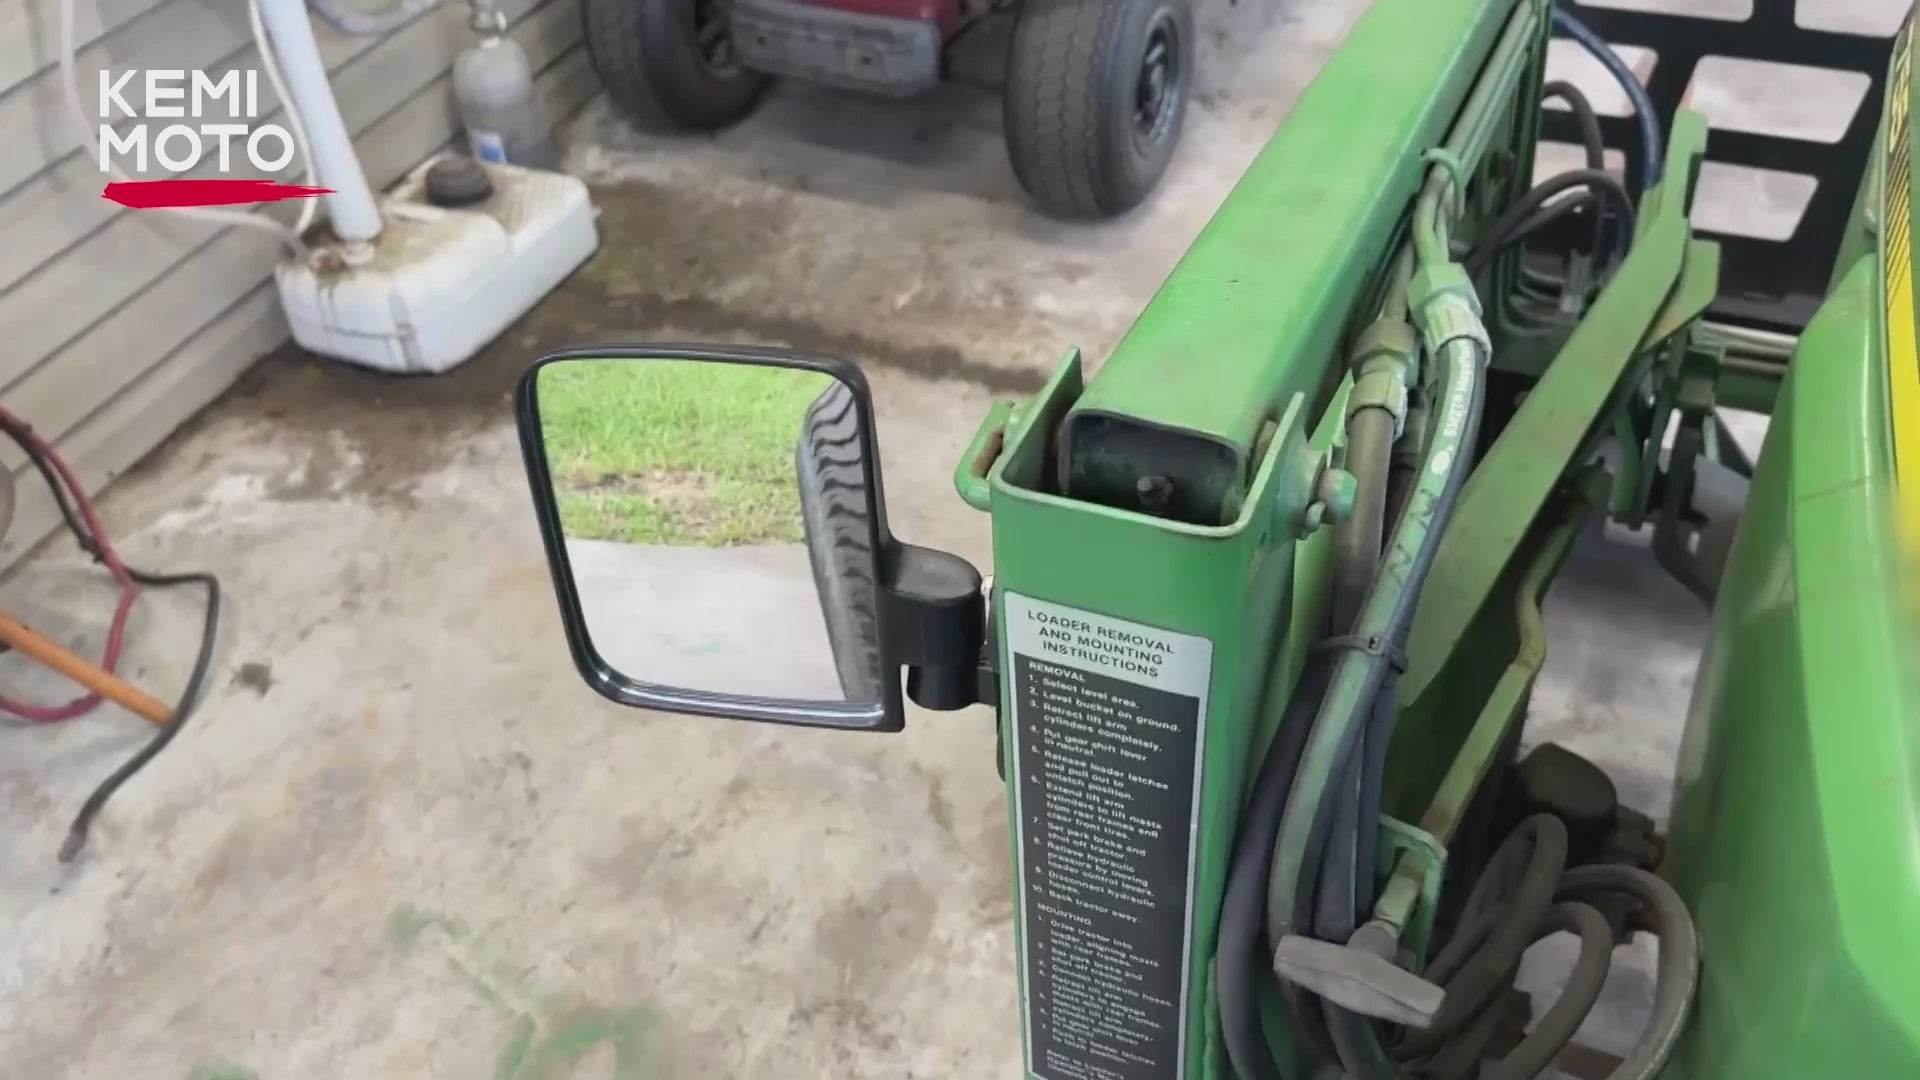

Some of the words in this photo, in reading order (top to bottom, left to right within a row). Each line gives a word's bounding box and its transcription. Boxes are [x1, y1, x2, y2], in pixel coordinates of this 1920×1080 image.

[1028, 610, 1090, 632] LOADER
[1097, 626, 1174, 654] REMOVAL
[1039, 627, 1071, 641] AND
[1078, 636, 1162, 664] MOUNTING
[1029, 661, 1085, 682] REMOVAL
[1043, 641, 1158, 677] INSTRUCTIONS
[1028, 673, 1038, 683] 1.
[1043, 678, 1077, 692] Select
[1081, 688, 1107, 700] level
[1112, 696, 1139, 708] area.
[1029, 686, 1038, 696] 2.
[1043, 691, 1071, 704] Level
[1076, 699, 1113, 714] bucket
[1118, 711, 1132, 719] on
[1136, 716, 1179, 732] ground.
[1030, 699, 1039, 708] 3.
[1044, 703, 1082, 720] Retract
[1087, 715, 1101, 724] lift
[1106, 721, 1126, 731] arm
[1044, 715, 1093, 732] cylinders
[1098, 729, 1162, 751] completely.
[1044, 728, 1060, 738] Put
[1065, 736, 1088, 745] gear
[1092, 742, 1115, 752] shift
[1120, 749, 1146, 761] lever
[1056, 742, 1096, 756] neutral.
[1045, 750, 1086, 767] Release
[1090, 763, 1124, 777] loader
[1128, 773, 1168, 789] latches
[1045, 762, 1064, 772] and
[1068, 768, 1088, 778] pull
[1092, 775, 1109, 784] out
[1113, 780, 1124, 788] to
[1046, 772, 1084, 786] unlatch
[1088, 784, 1134, 800] position.
[1046, 781, 1082, 798] Extend
[1086, 793, 1100, 802] lift
[1104, 799, 1124, 809] arm
[1046, 793, 1094, 810] cylinders
[1112, 810, 1125, 819] lift
[1130, 816, 1161, 829] masts
[1047, 801, 1070, 813] from
[1074, 810, 1094, 819] rear
[1098, 816, 1134, 831] frames
[1138, 829, 1158, 838] and
[1047, 812, 1072, 822] clear
[1076, 819, 1100, 830] front
[1104, 827, 1130, 840] tires.
[1048, 833, 1069, 843] shut
[1048, 822, 1063, 832] Set
[1068, 829, 1089, 840] park
[1094, 835, 1123, 849] brake
[1126, 846, 1146, 856] and
[1047, 841, 1084, 857] Relieve
[1087, 853, 1135, 872] hydraulic
[1048, 852, 1091, 868] pressure
[1096, 865, 1107, 874] by
[1048, 860, 1078, 874] loader
[1082, 871, 1118, 885] control
[1048, 870, 1104, 892] Disconnect
[1108, 888, 1154, 908] hydraulic
[1049, 890, 1072, 902] Back
[1076, 899, 1108, 913] tractor
[1037, 903, 1091, 925] MOUNTING
